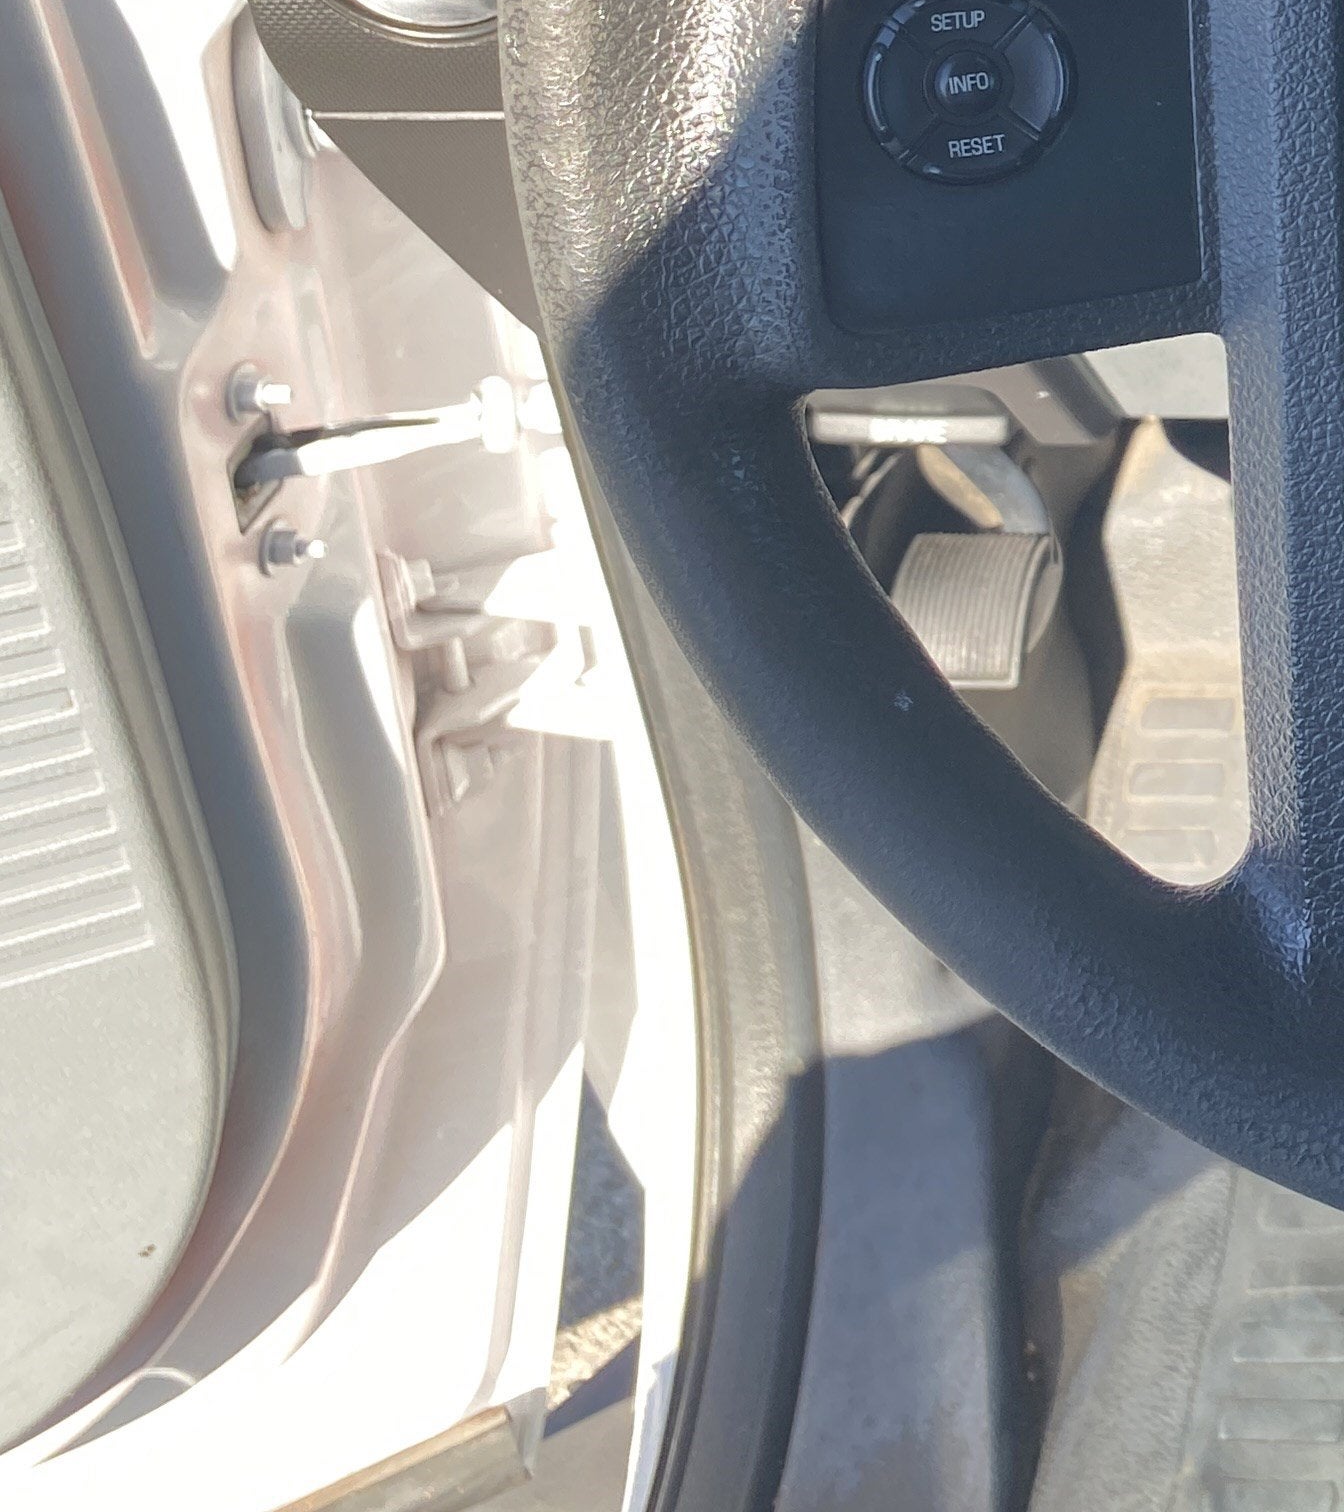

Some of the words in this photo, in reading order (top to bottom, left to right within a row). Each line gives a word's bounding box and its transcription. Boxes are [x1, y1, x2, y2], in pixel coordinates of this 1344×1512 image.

[930, 9, 986, 32] SETUP
[948, 71, 989, 95] INFO
[948, 133, 1006, 159] RESET
